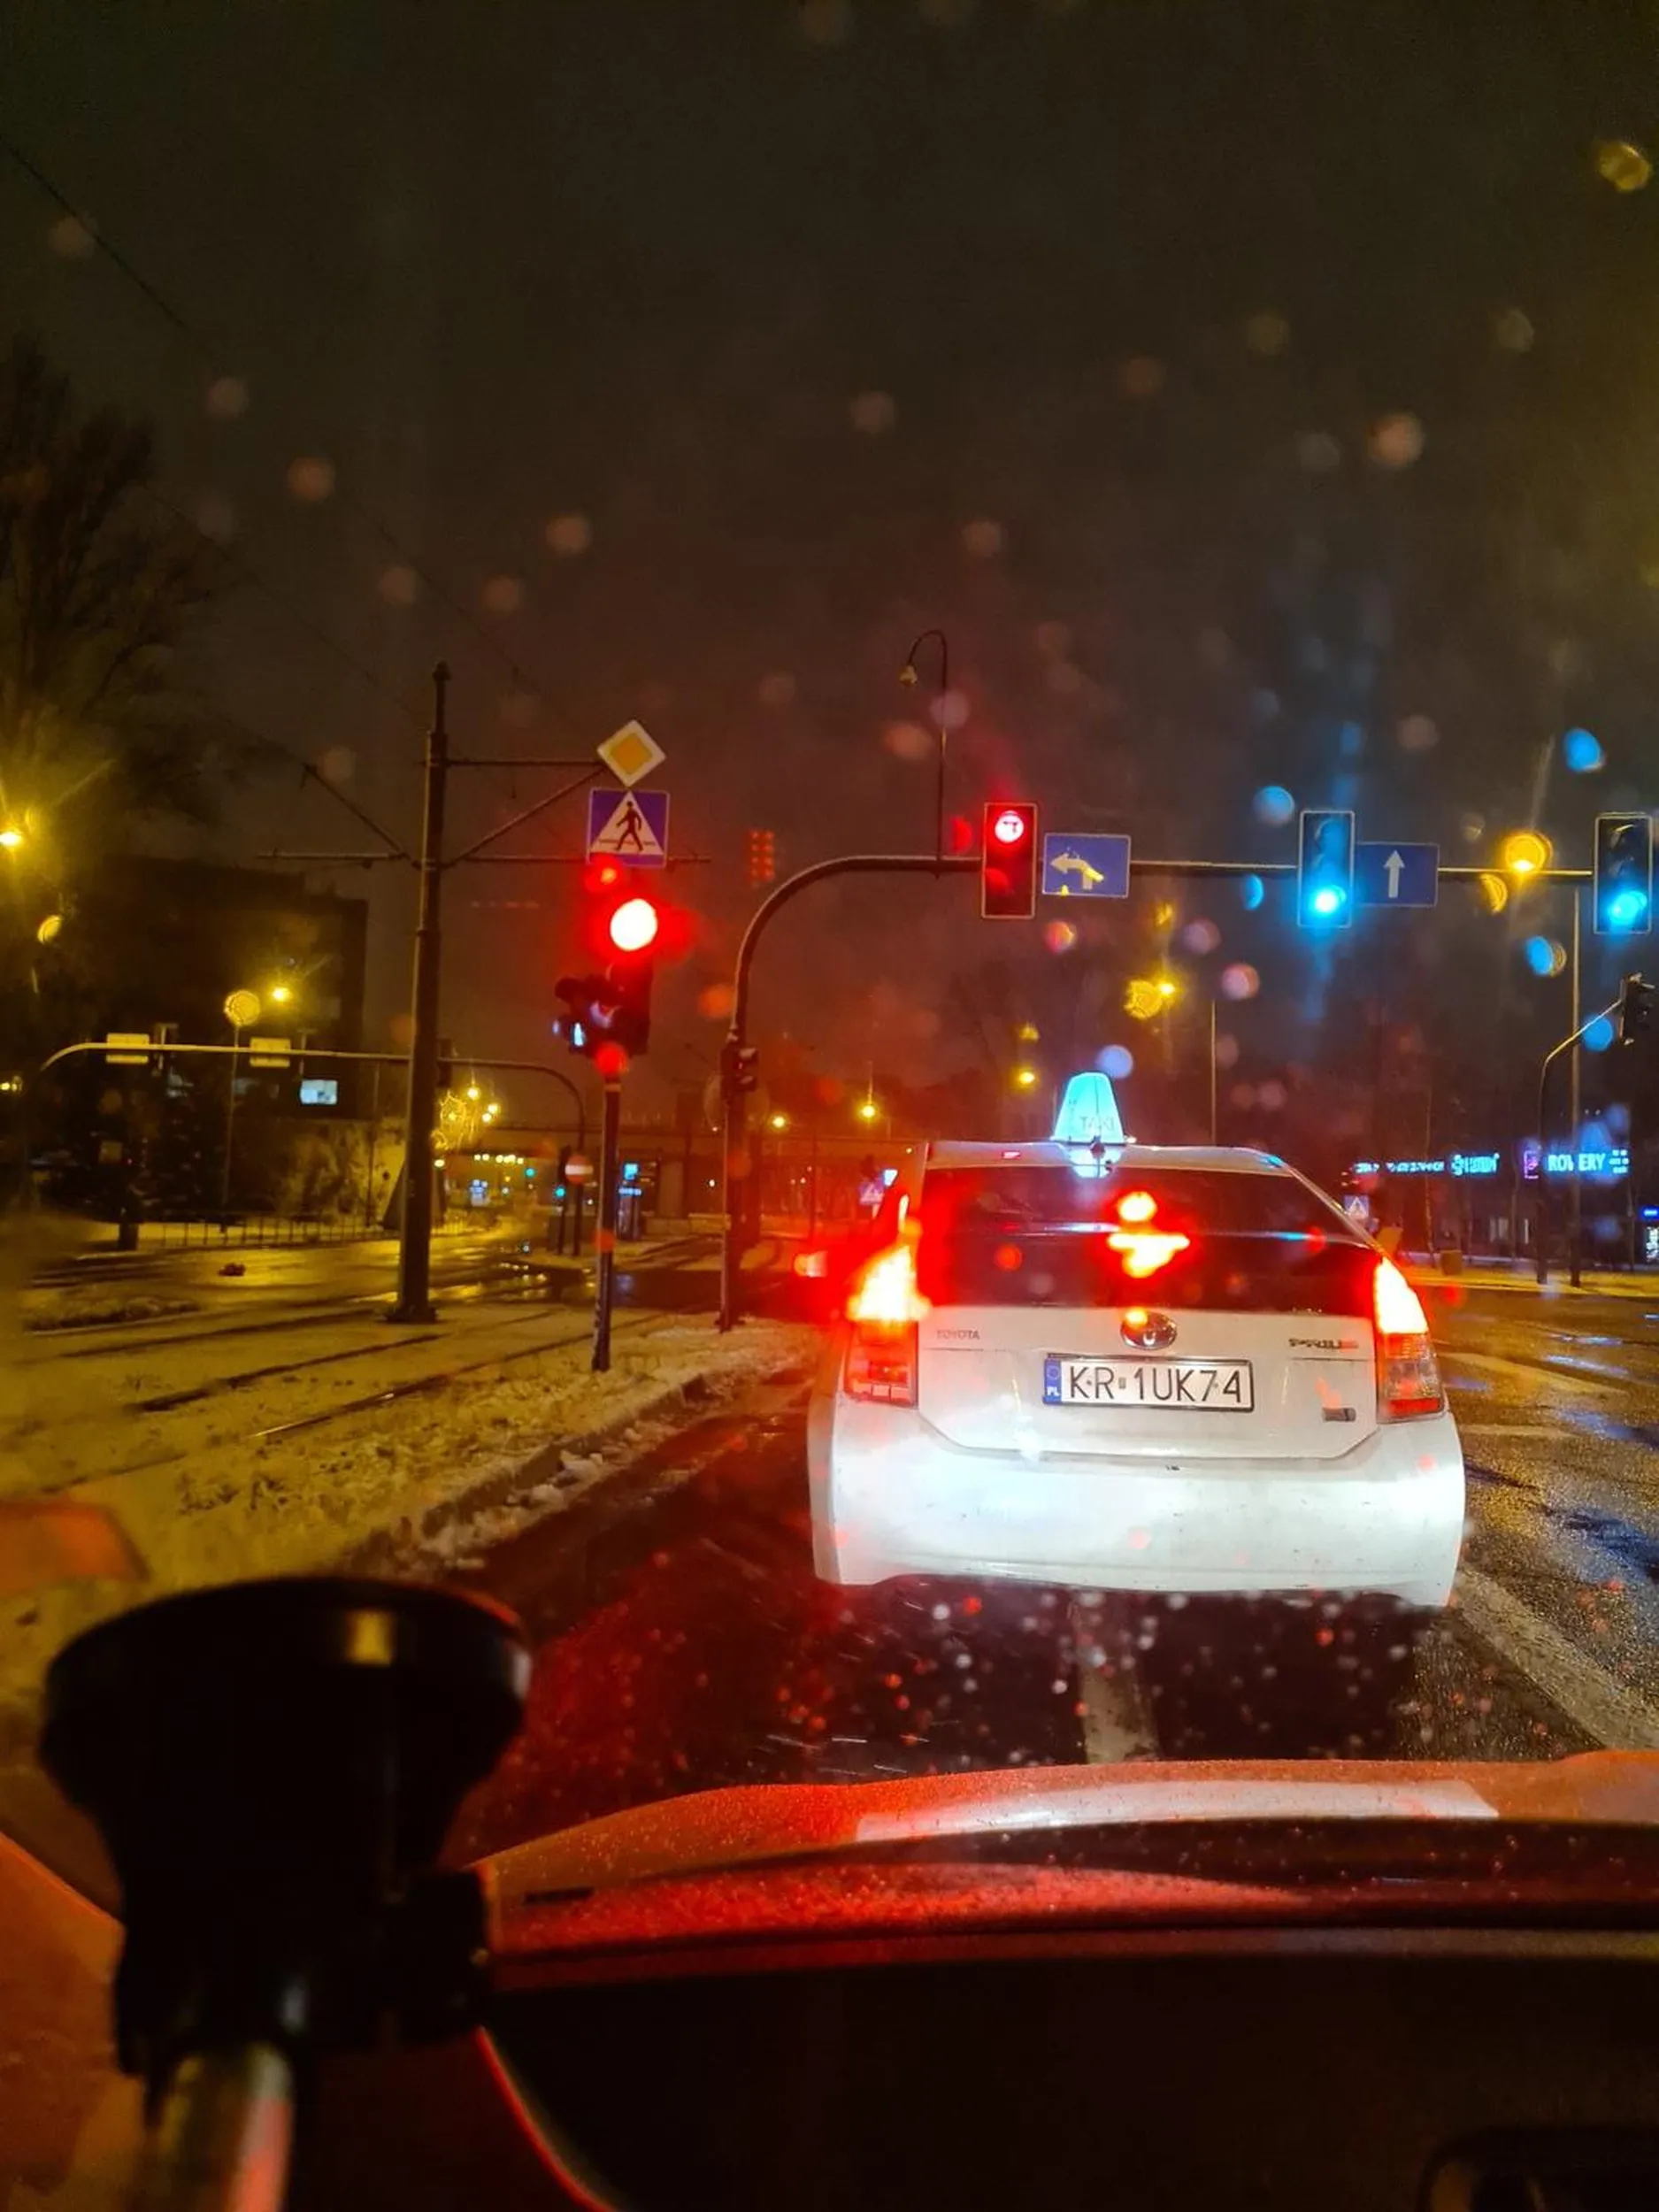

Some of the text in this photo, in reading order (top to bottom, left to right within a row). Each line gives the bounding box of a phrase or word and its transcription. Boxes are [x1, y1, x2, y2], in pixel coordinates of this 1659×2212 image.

[936, 1329, 981, 1340] TOYOTA
[1069, 1365, 1242, 1403] KR 1UK74
[1046, 1386, 1060, 1397] PL
